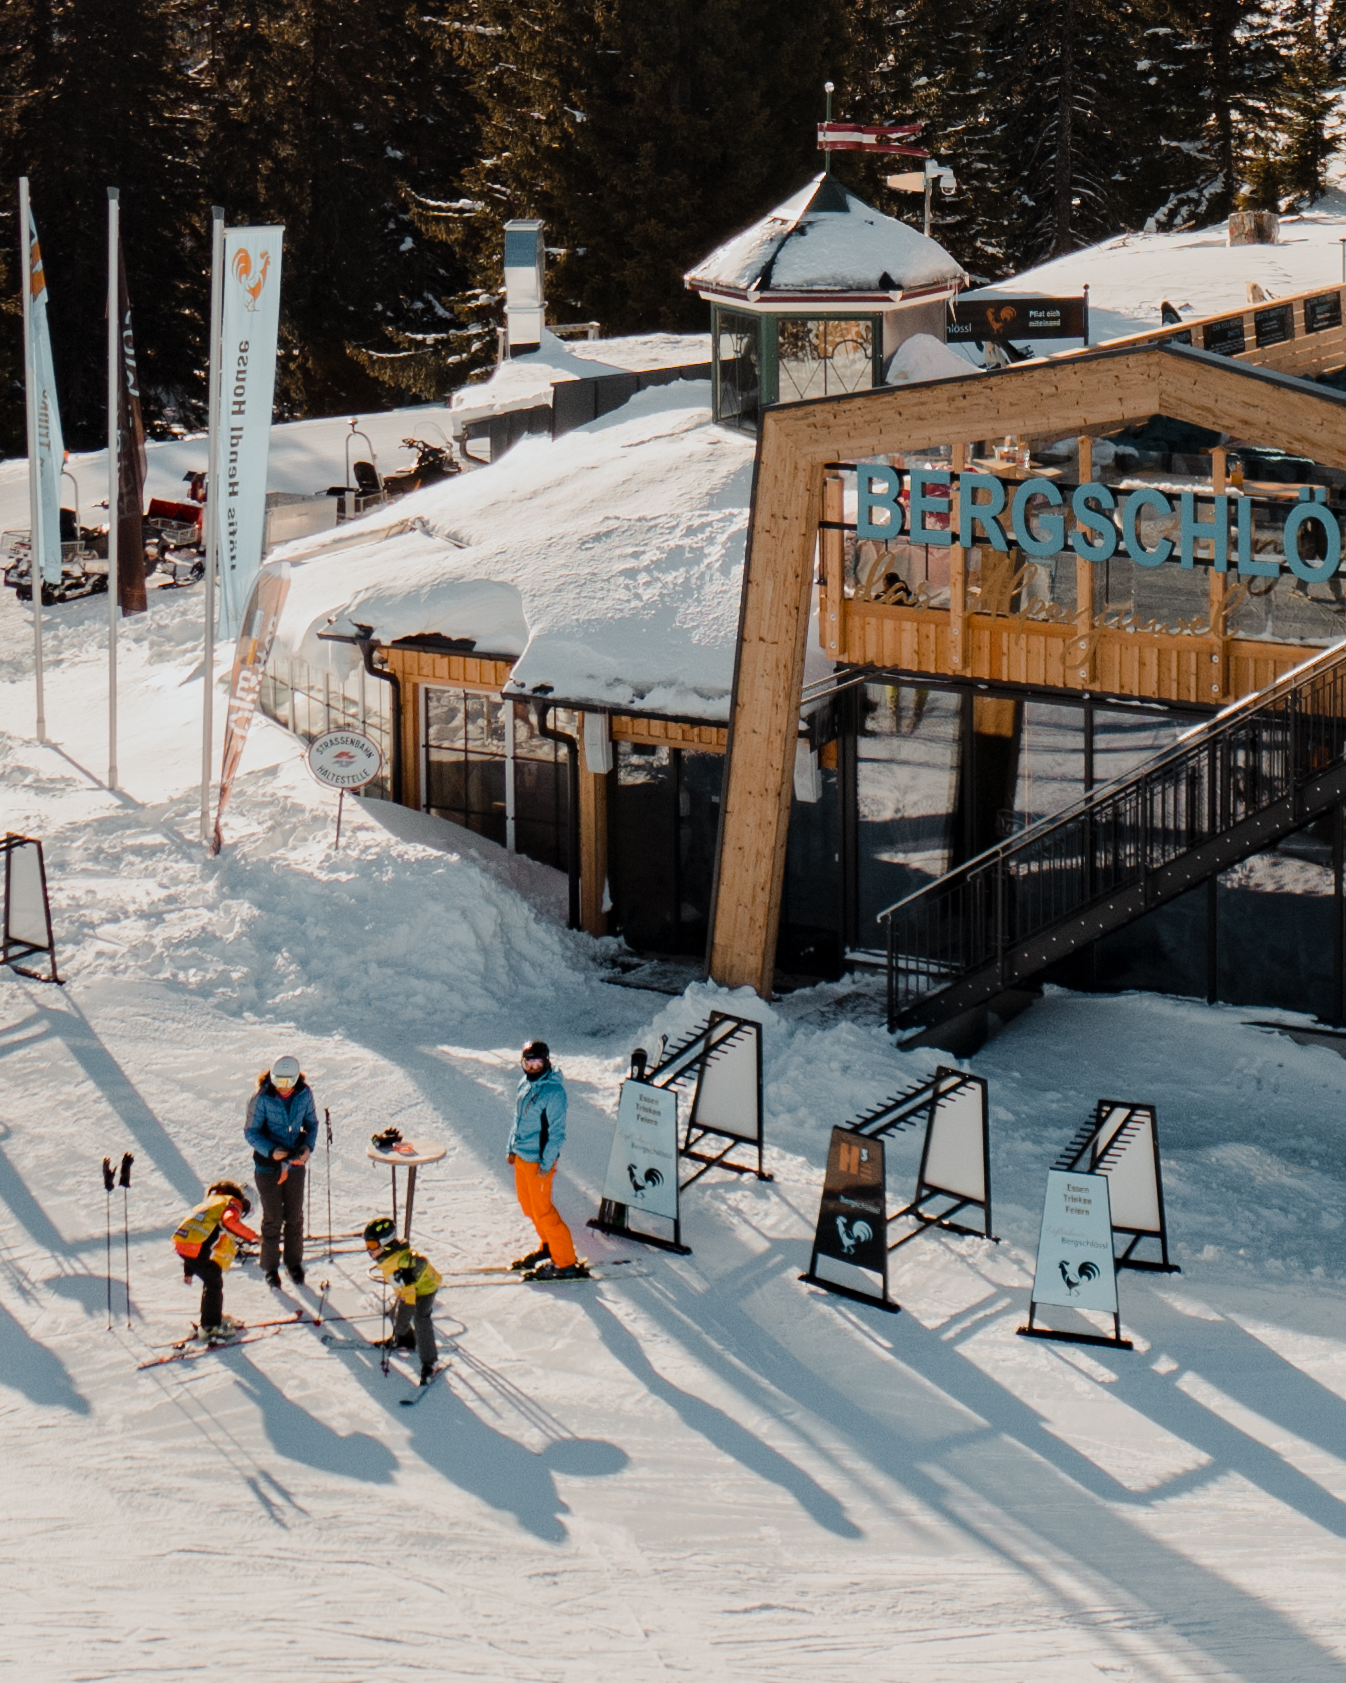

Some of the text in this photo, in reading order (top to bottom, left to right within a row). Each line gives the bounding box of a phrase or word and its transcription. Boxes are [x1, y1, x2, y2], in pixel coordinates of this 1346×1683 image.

[853, 550, 944, 613] das
[316, 736, 374, 759] STRASSENBAHN
[317, 765, 370, 784] HALTESTELLE
